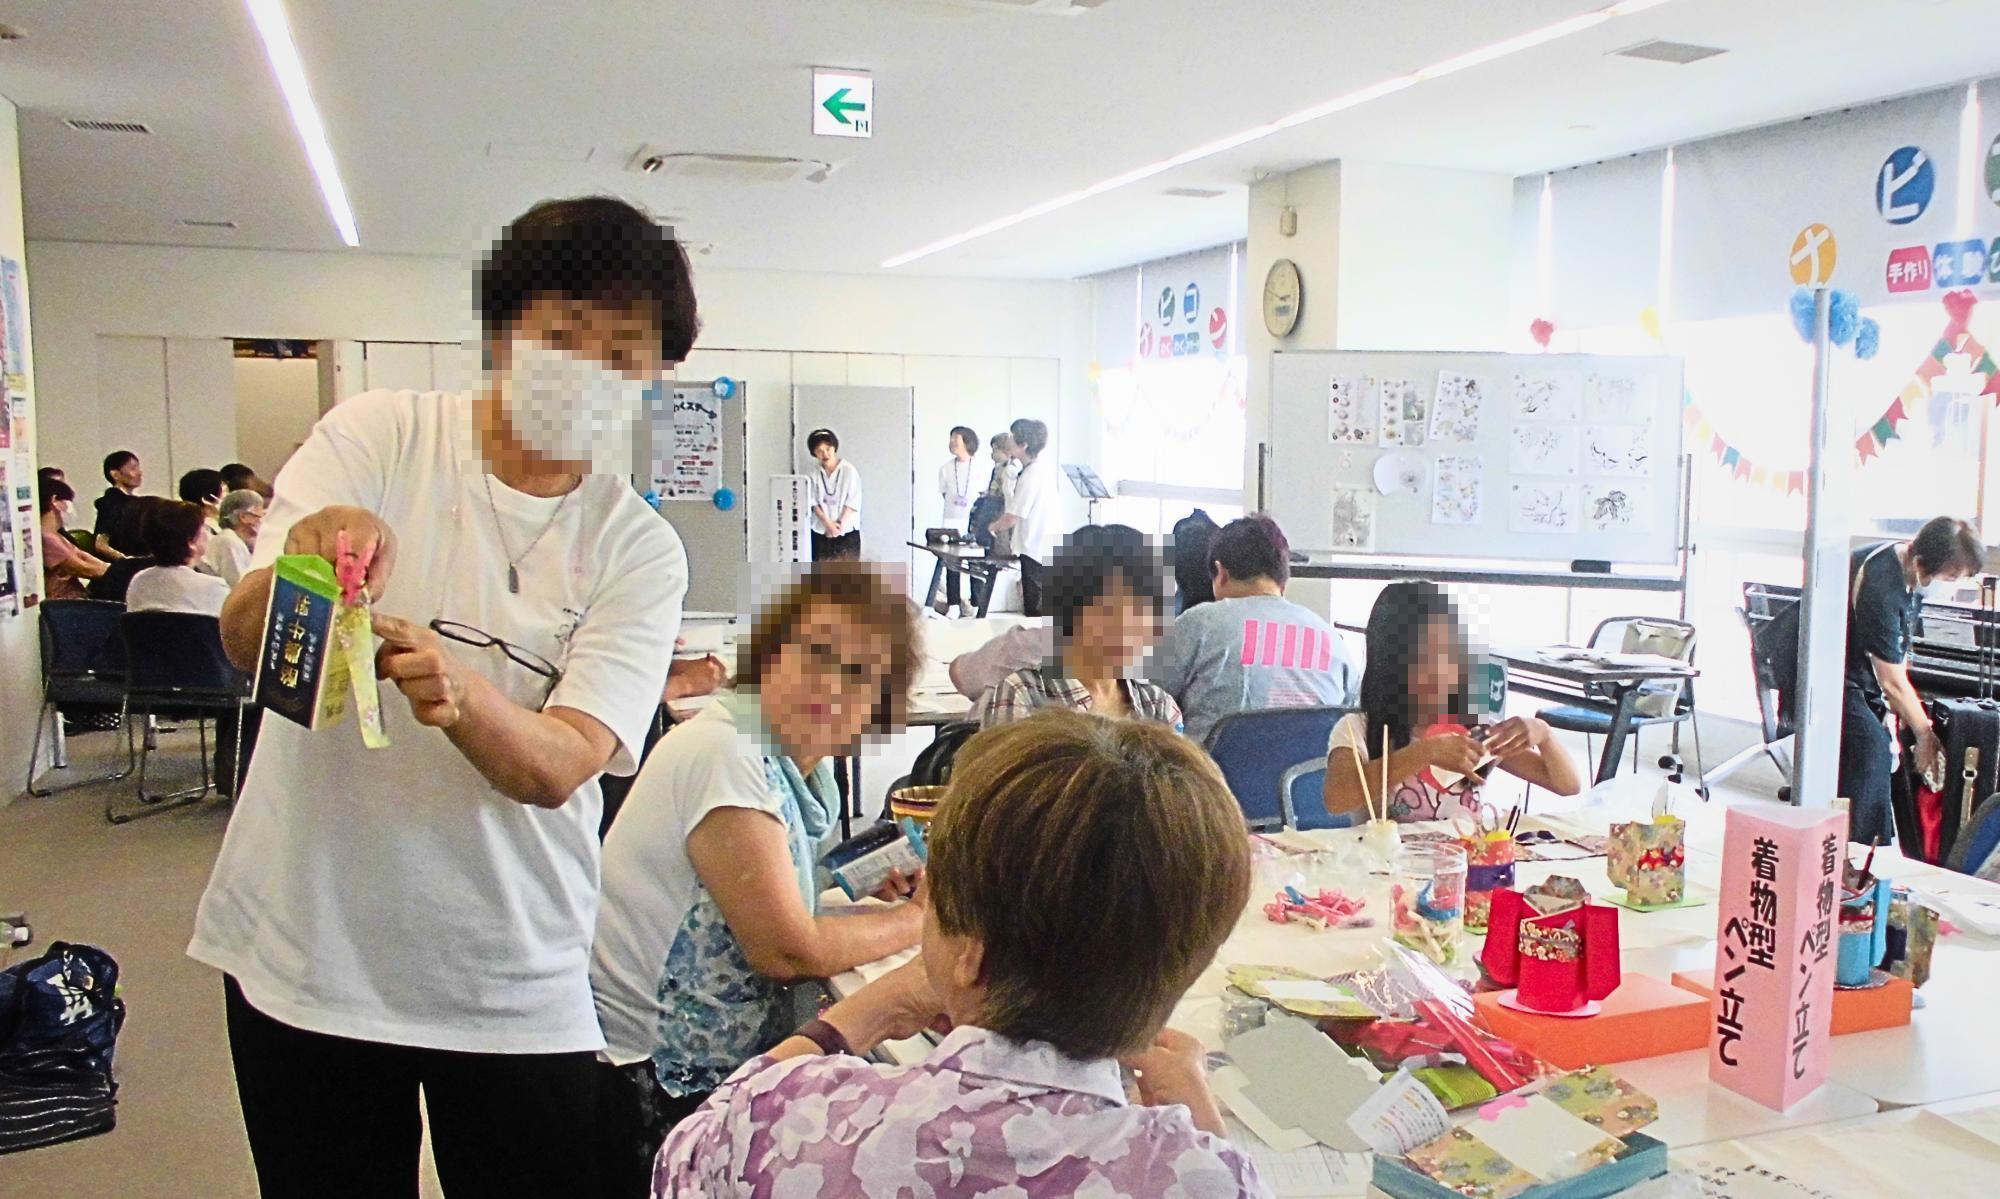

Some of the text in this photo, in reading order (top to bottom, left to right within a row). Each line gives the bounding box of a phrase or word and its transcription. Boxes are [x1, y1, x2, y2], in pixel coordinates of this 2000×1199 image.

[1887, 260, 1929, 285] 手作り
[1747, 836, 1779, 970] 着物型
[1815, 832, 1837, 964] 着物型
[1717, 916, 1748, 1067] ペン立て
[1792, 925, 1816, 1080] ペン立て
